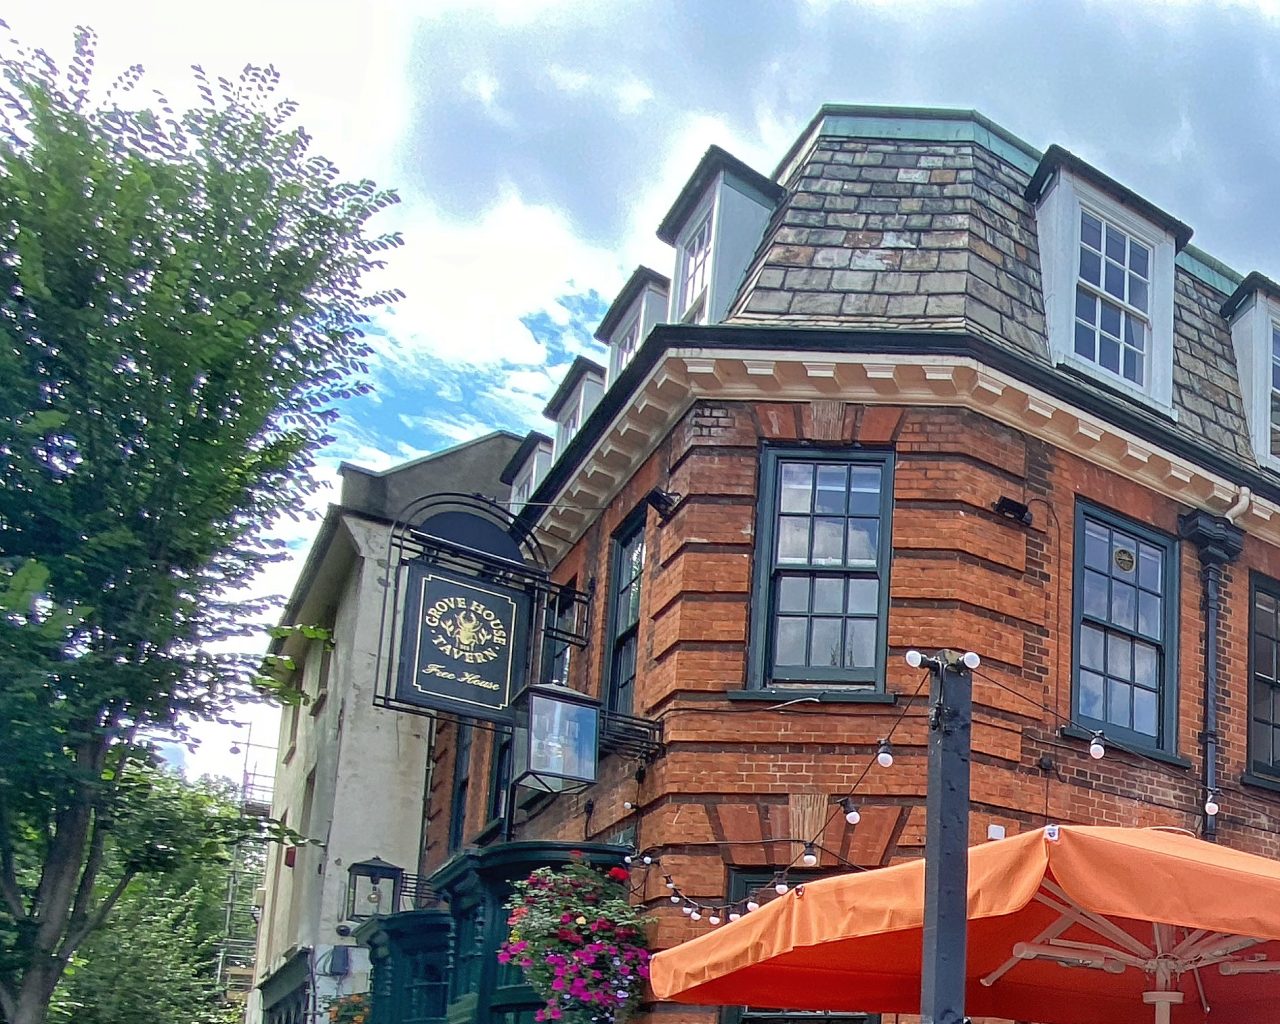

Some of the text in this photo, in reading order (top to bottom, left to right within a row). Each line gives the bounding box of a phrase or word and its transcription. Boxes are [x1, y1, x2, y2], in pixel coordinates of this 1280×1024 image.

[425, 597, 507, 646] GROVE HOUSE
[431, 634, 498, 664] TAVERN
[421, 663, 500, 691] Free House
